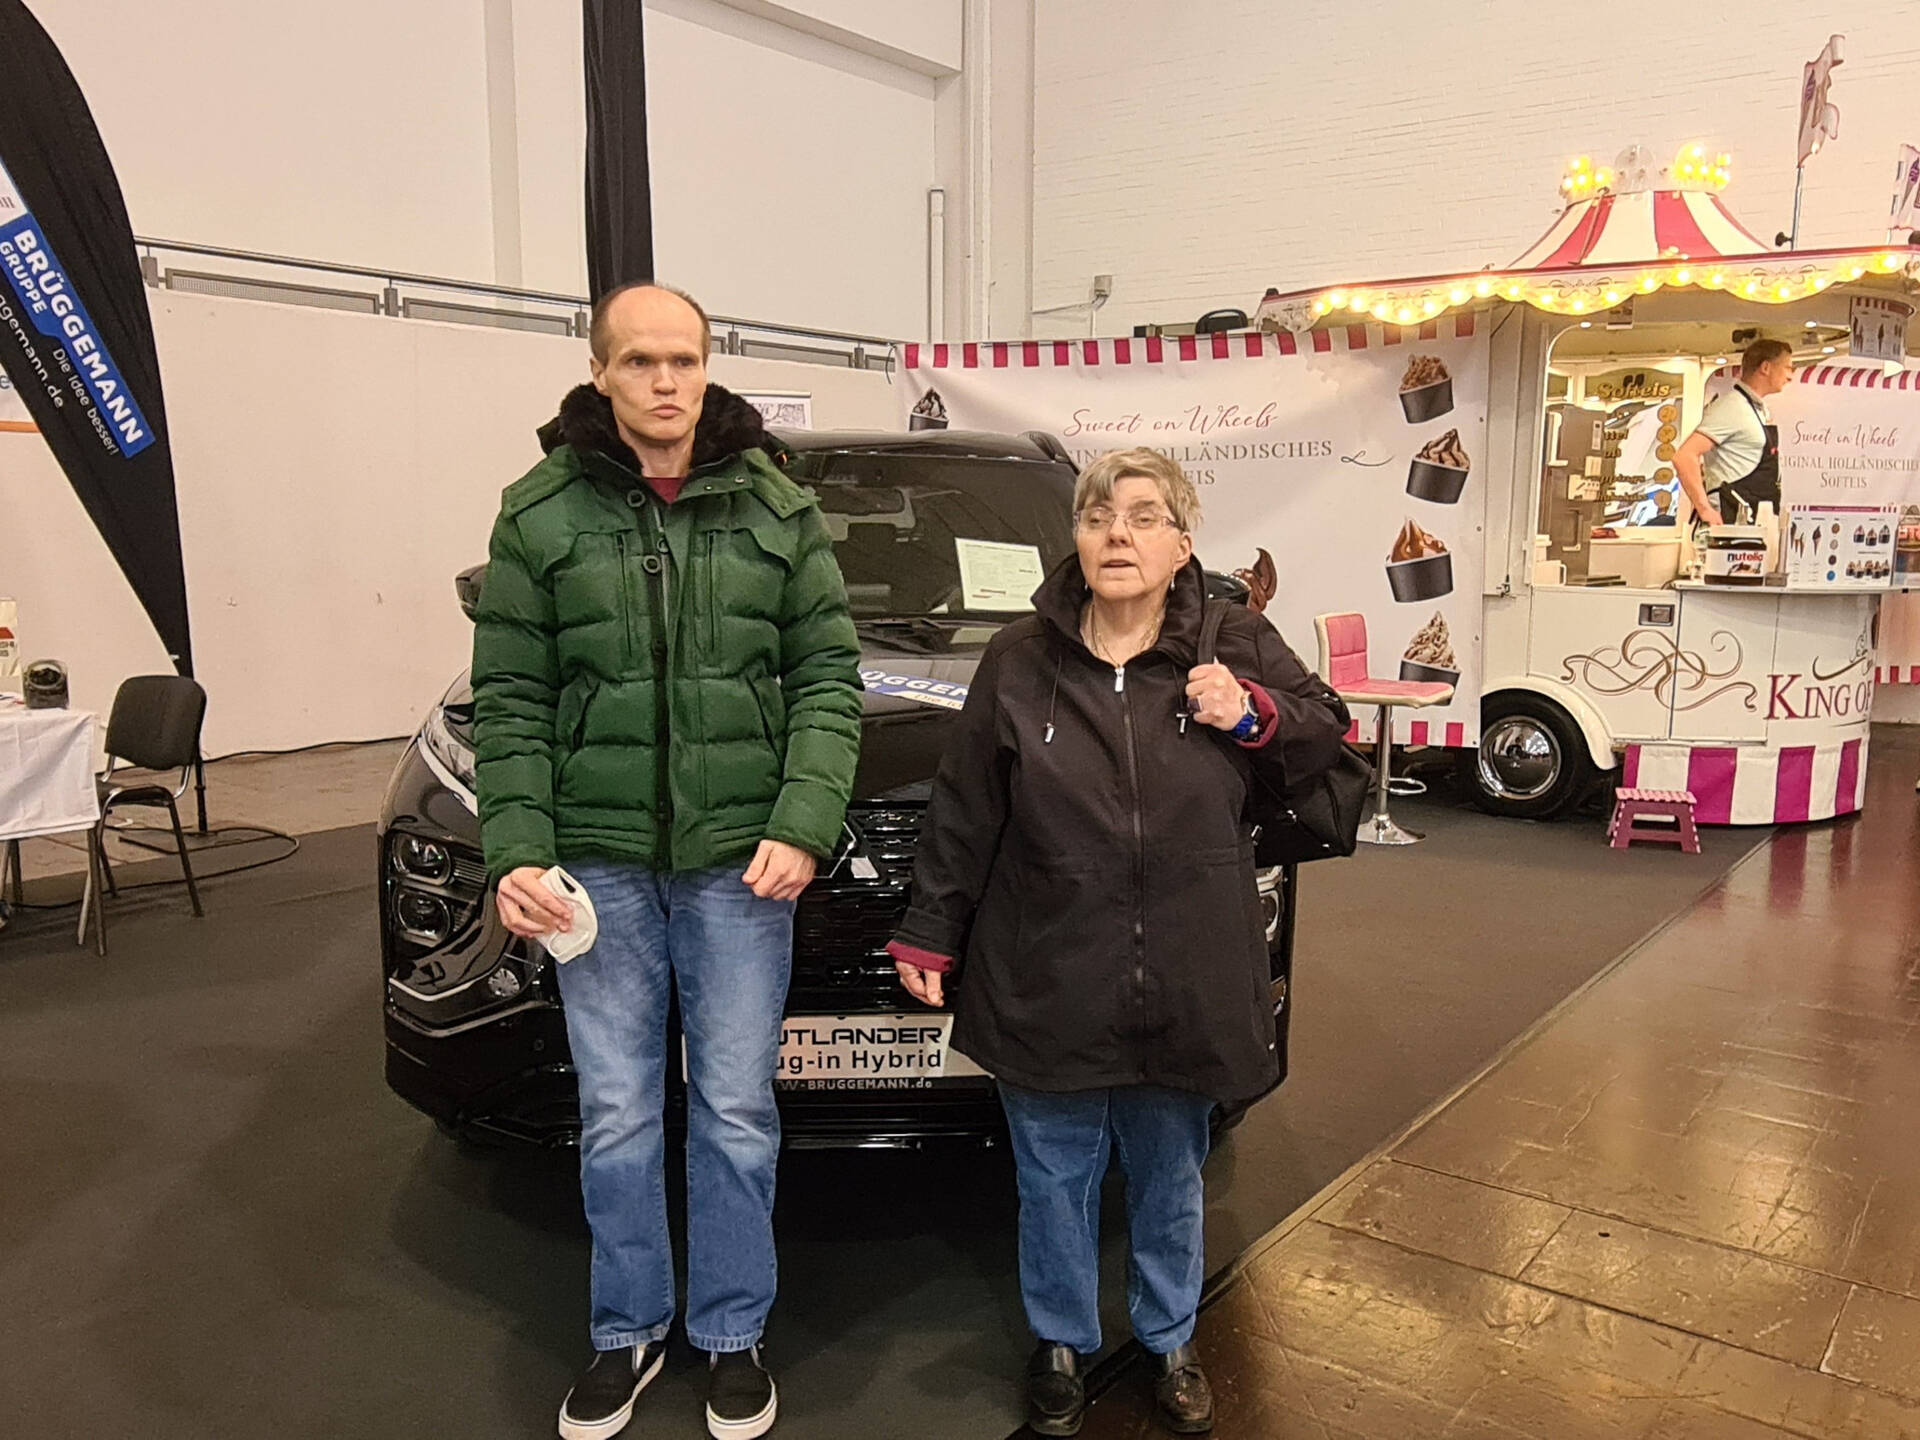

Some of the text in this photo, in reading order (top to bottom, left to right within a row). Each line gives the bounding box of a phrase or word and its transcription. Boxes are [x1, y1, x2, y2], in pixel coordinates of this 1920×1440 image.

[0, 241, 48, 314] GRUPPE
[0, 294, 64, 408] gemann.de
[13, 229, 143, 445] BRÜGGEMANN
[52, 348, 71, 373] Die
[86, 407, 119, 456] besser!
[1063, 408, 1143, 437] Sweet
[1184, 402, 1279, 436] Wheels
[1156, 440, 1332, 463] OLLÄNDISCHES
[777, 1050, 941, 1074] ug-in Hybrid
[778, 1027, 942, 1046] UTLANDER
